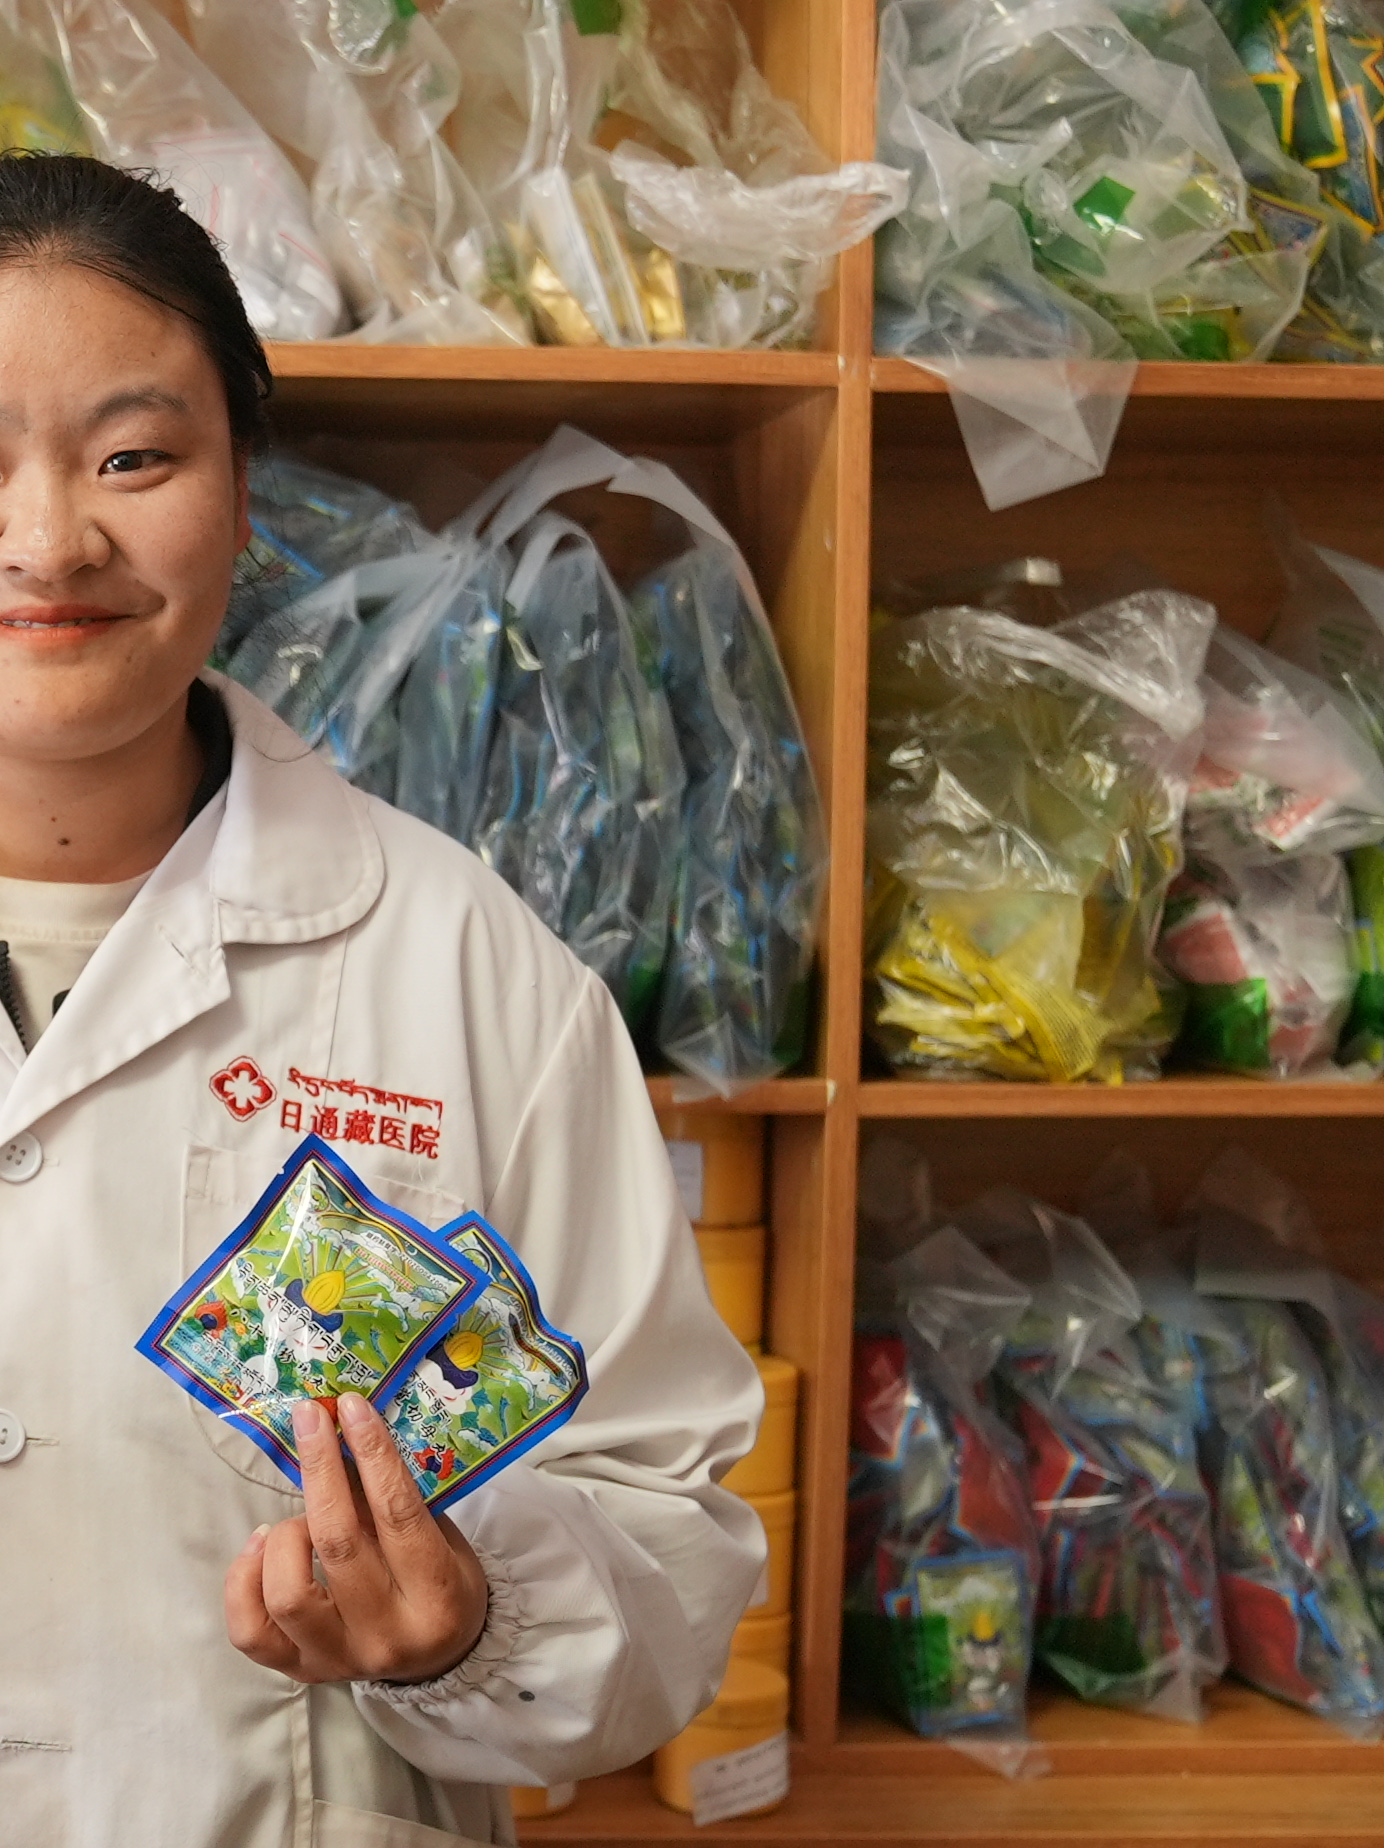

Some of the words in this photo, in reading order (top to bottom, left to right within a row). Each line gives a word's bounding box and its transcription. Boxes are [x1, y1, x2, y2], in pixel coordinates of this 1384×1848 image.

[279, 1099, 443, 1159] 日通藏医院
